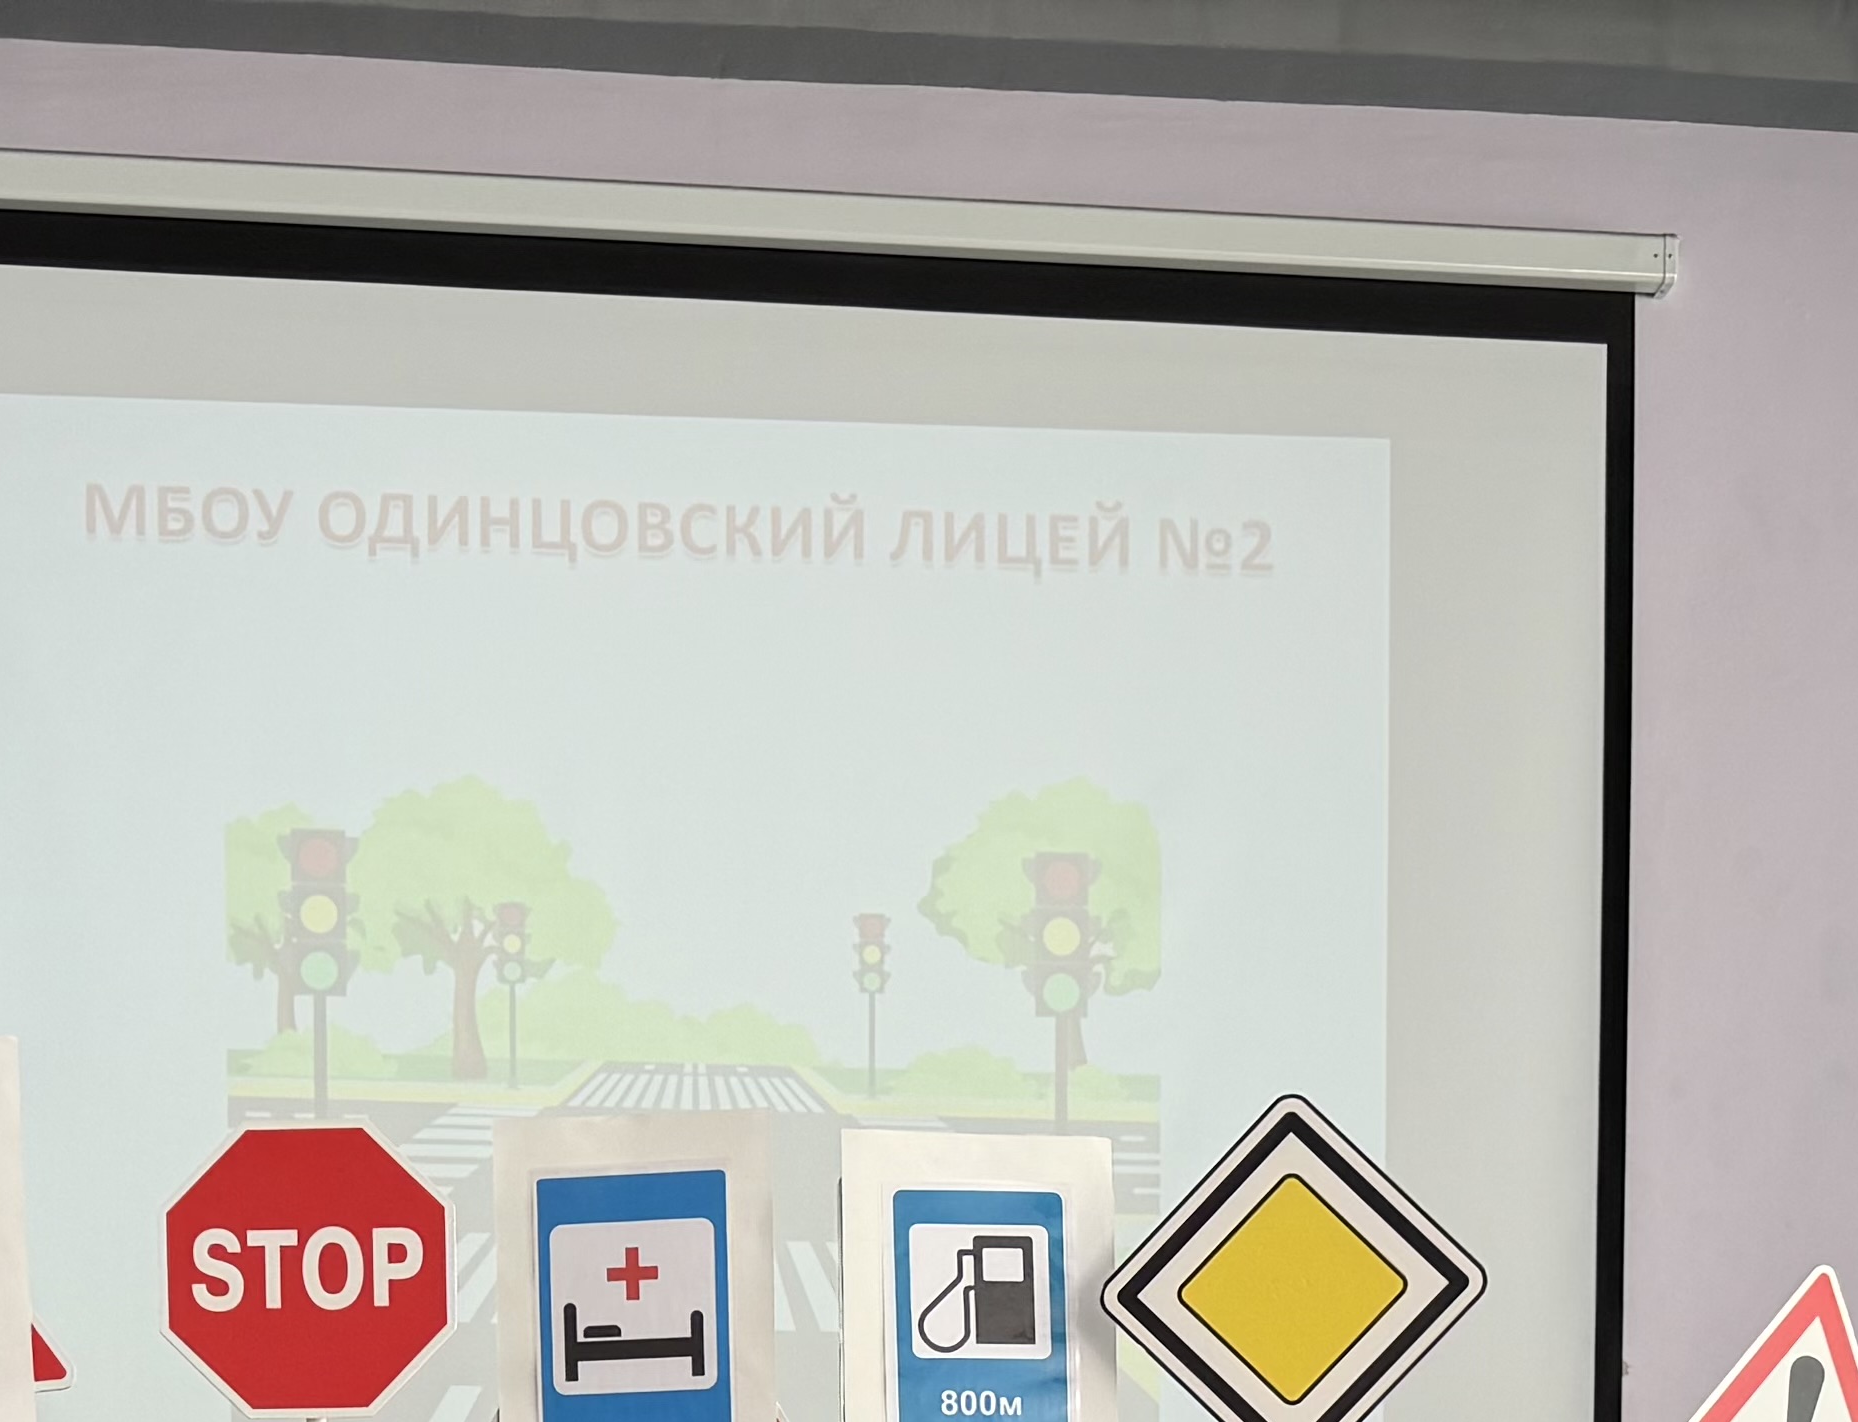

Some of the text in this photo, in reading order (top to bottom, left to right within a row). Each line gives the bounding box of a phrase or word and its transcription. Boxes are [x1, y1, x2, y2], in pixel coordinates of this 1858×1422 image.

[82, 481, 1276, 577] МБОУ ОДИНЦОВСКИЙ ЛИЦЕЙ №2
[192, 1226, 423, 1312] STOP
[941, 1389, 1022, 1416] 800м
